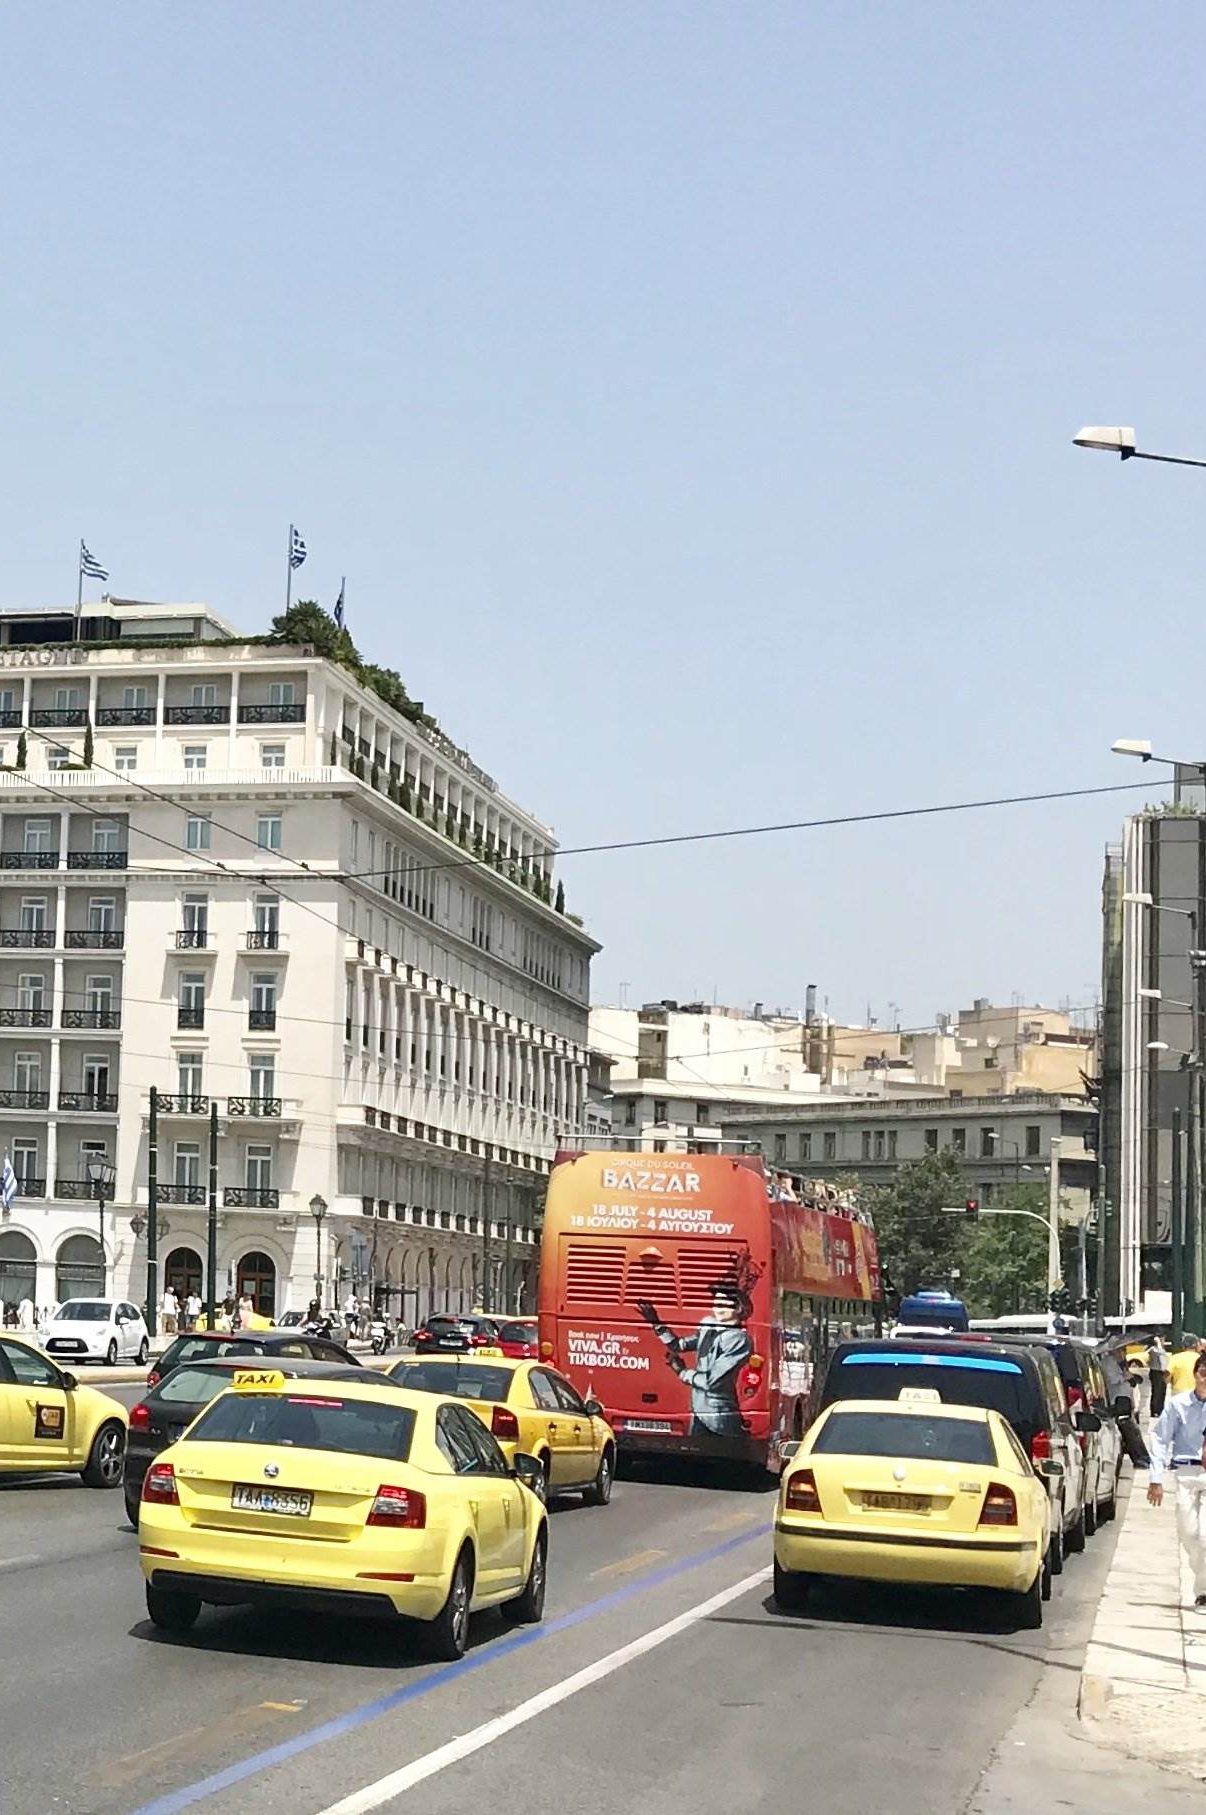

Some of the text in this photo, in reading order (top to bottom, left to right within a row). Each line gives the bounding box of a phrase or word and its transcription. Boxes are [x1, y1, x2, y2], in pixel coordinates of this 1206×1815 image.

[611, 1158, 694, 1170] CIRQUE DU SOLEIL
[602, 1168, 701, 1193] BAZZAR
[592, 1204, 607, 1216] 18
[609, 1204, 640, 1217] JULY
[646, 1207, 656, 1218] 4
[658, 1208, 714, 1221] AUGUST
[570, 1215, 584, 1227] 18
[587, 1216, 640, 1229] ΙΟΥΛΙΟΥ
[646, 1219, 657, 1231] 4
[568, 1339, 621, 1354] VIVA.GR
[568, 1352, 650, 1370] TIXBOX.COM
[236, 1374, 276, 1384] TAXI
